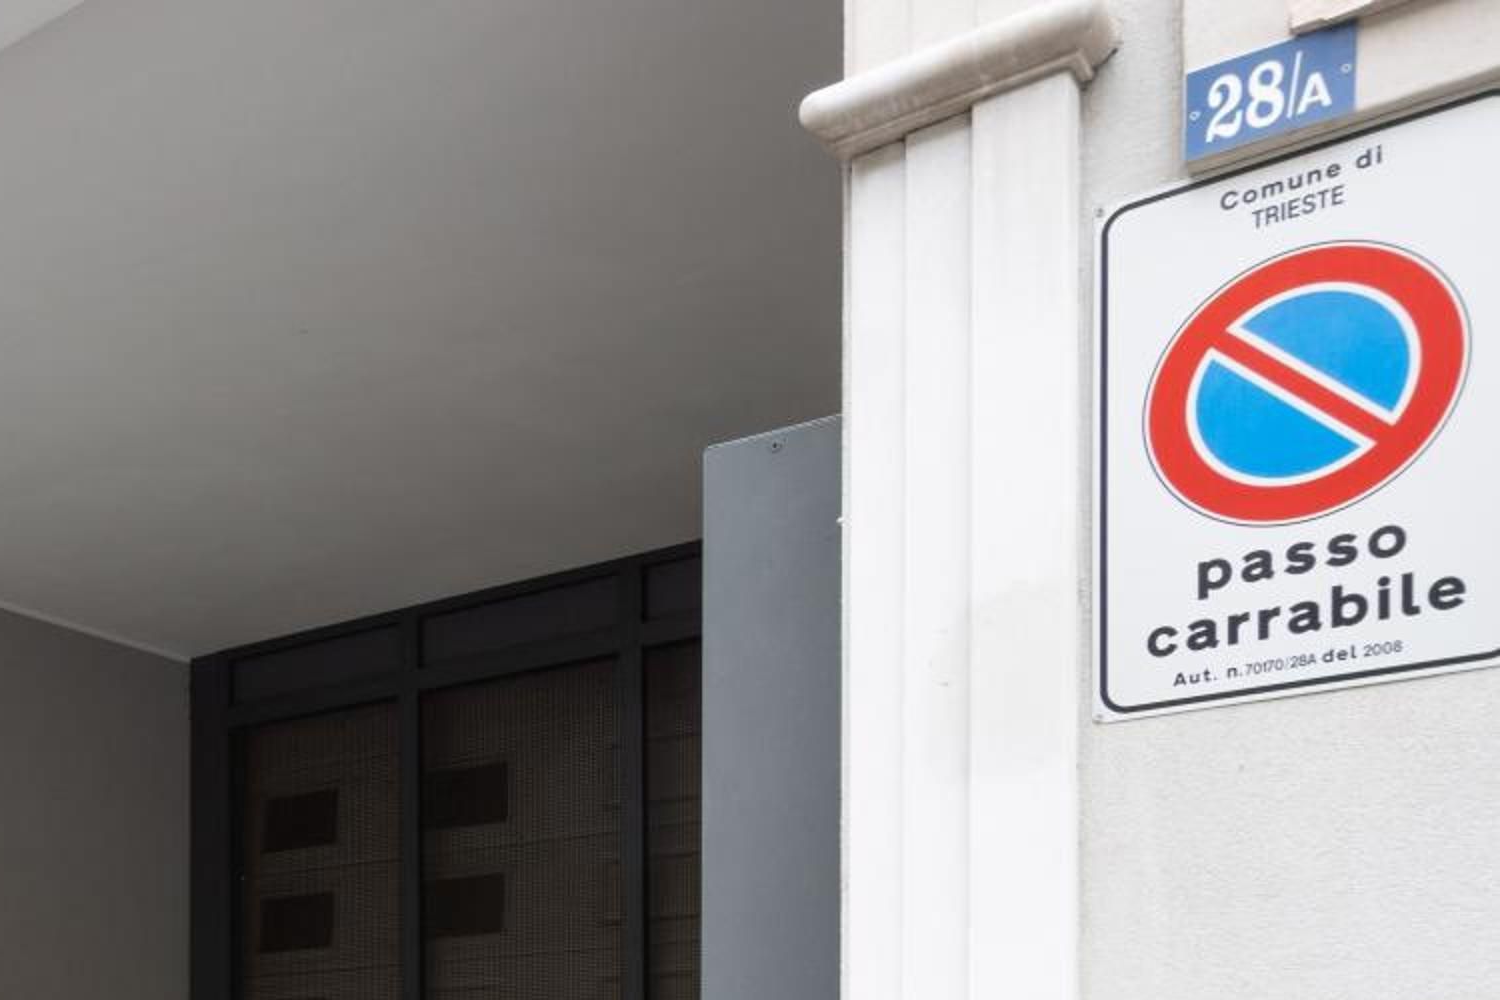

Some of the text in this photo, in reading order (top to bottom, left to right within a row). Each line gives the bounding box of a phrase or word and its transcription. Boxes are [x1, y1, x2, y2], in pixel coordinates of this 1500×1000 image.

[1205, 51, 1333, 143] 28/A
[1220, 144, 1383, 211] Comune di
[1252, 184, 1346, 229] TRIESTE
[1197, 525, 1408, 600] passo
[1146, 571, 1467, 658] carrabile
[1172, 666, 1218, 687] Aut.
[1322, 644, 1357, 663] del
[1363, 639, 1404, 658] 2008
